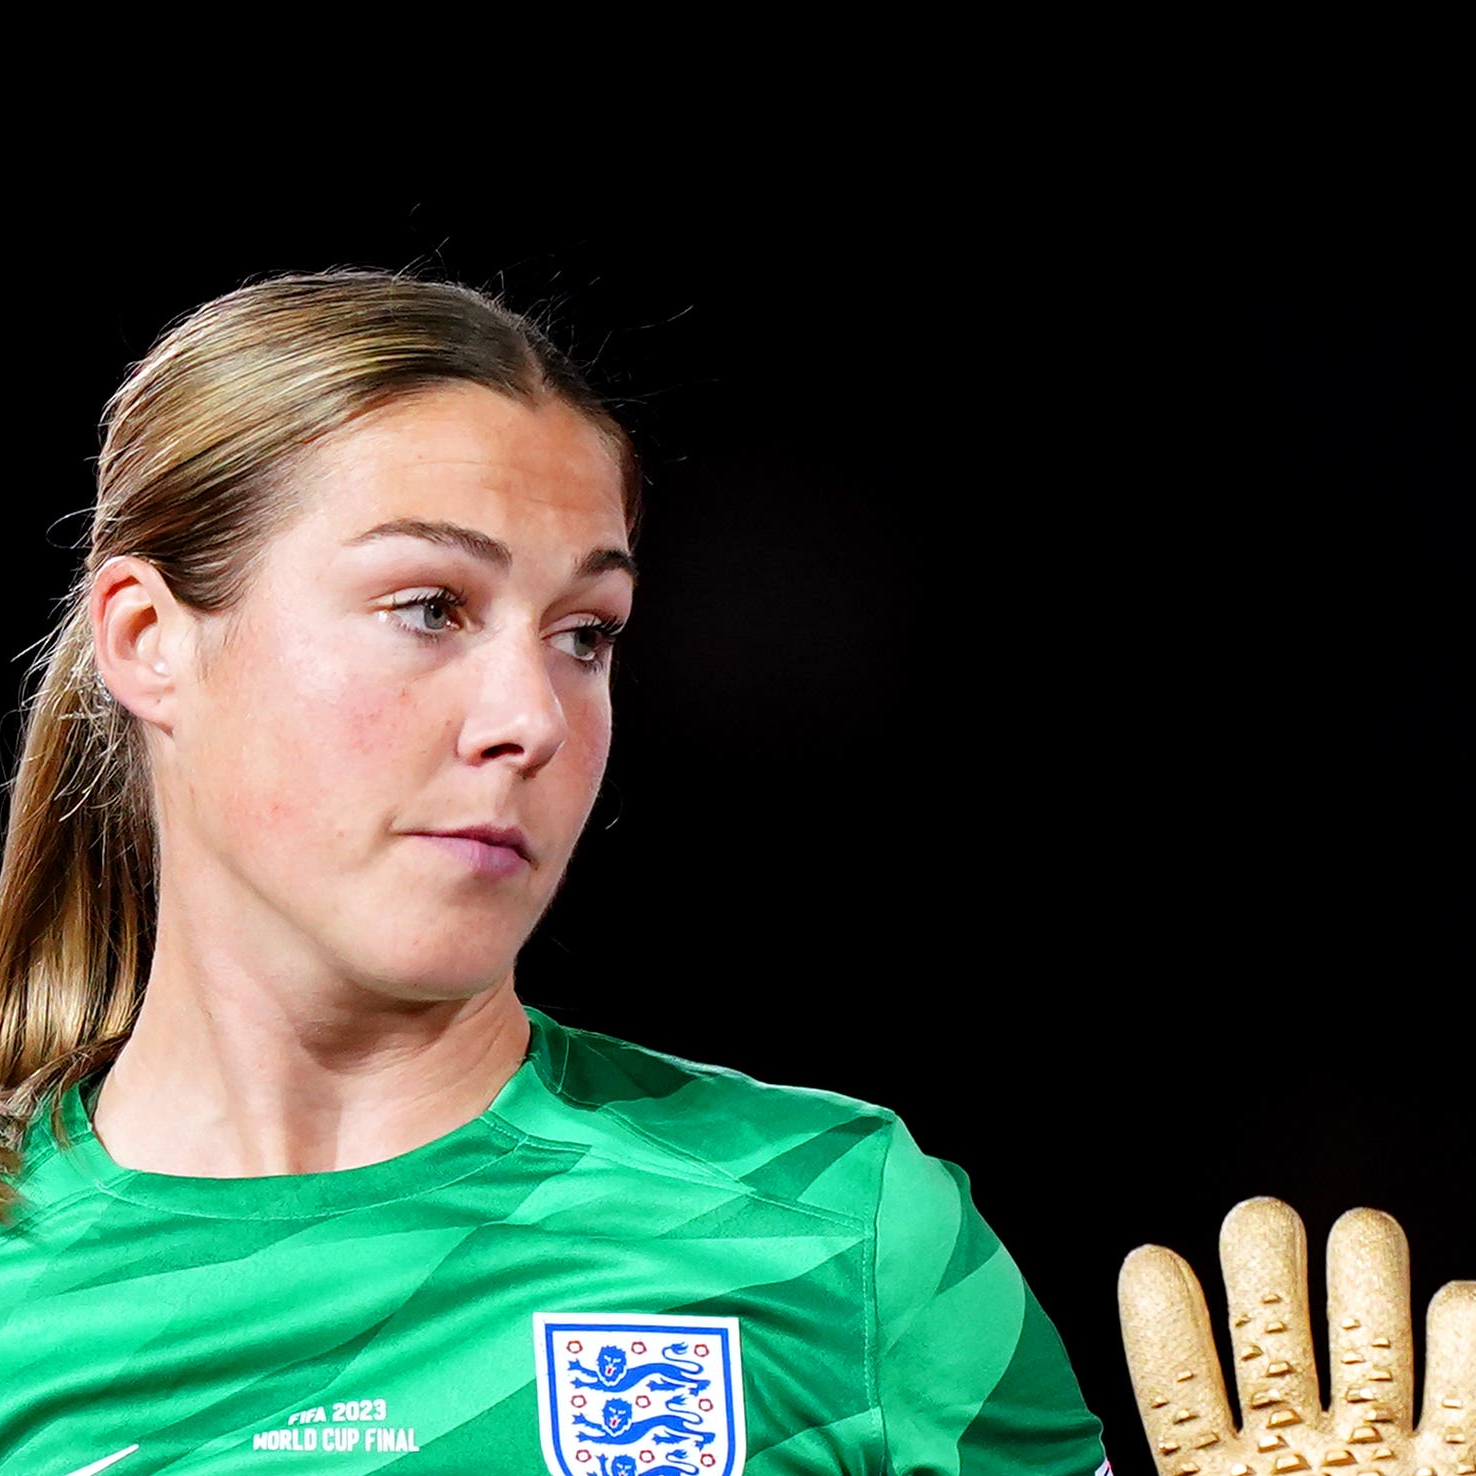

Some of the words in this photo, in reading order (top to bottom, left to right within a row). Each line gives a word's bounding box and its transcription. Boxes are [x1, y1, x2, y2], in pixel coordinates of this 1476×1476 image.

[288, 1406, 326, 1426] FIFA
[332, 1398, 387, 1422] 2023
[253, 1428, 317, 1451] WORLD
[322, 1428, 360, 1452] CUP
[365, 1428, 420, 1453] FINAL
